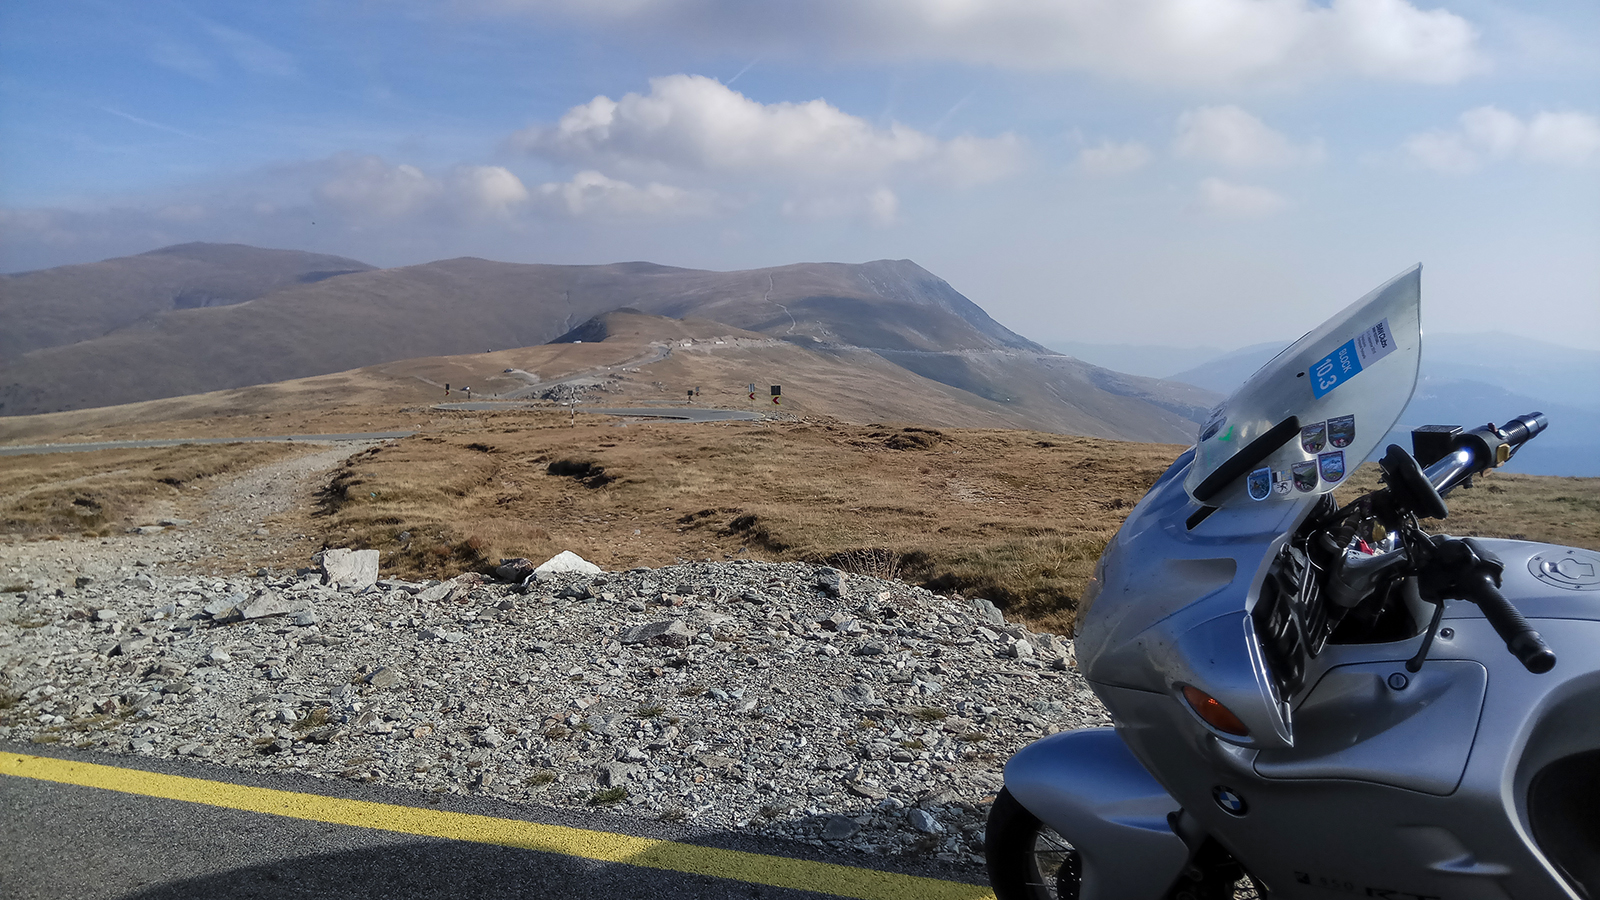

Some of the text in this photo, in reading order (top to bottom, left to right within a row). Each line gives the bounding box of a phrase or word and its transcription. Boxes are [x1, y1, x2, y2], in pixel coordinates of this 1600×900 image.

[1379, 332, 1389, 349] Clubs
[1316, 358, 1337, 390] 10.3
[1338, 348, 1352, 374] BLOCK
